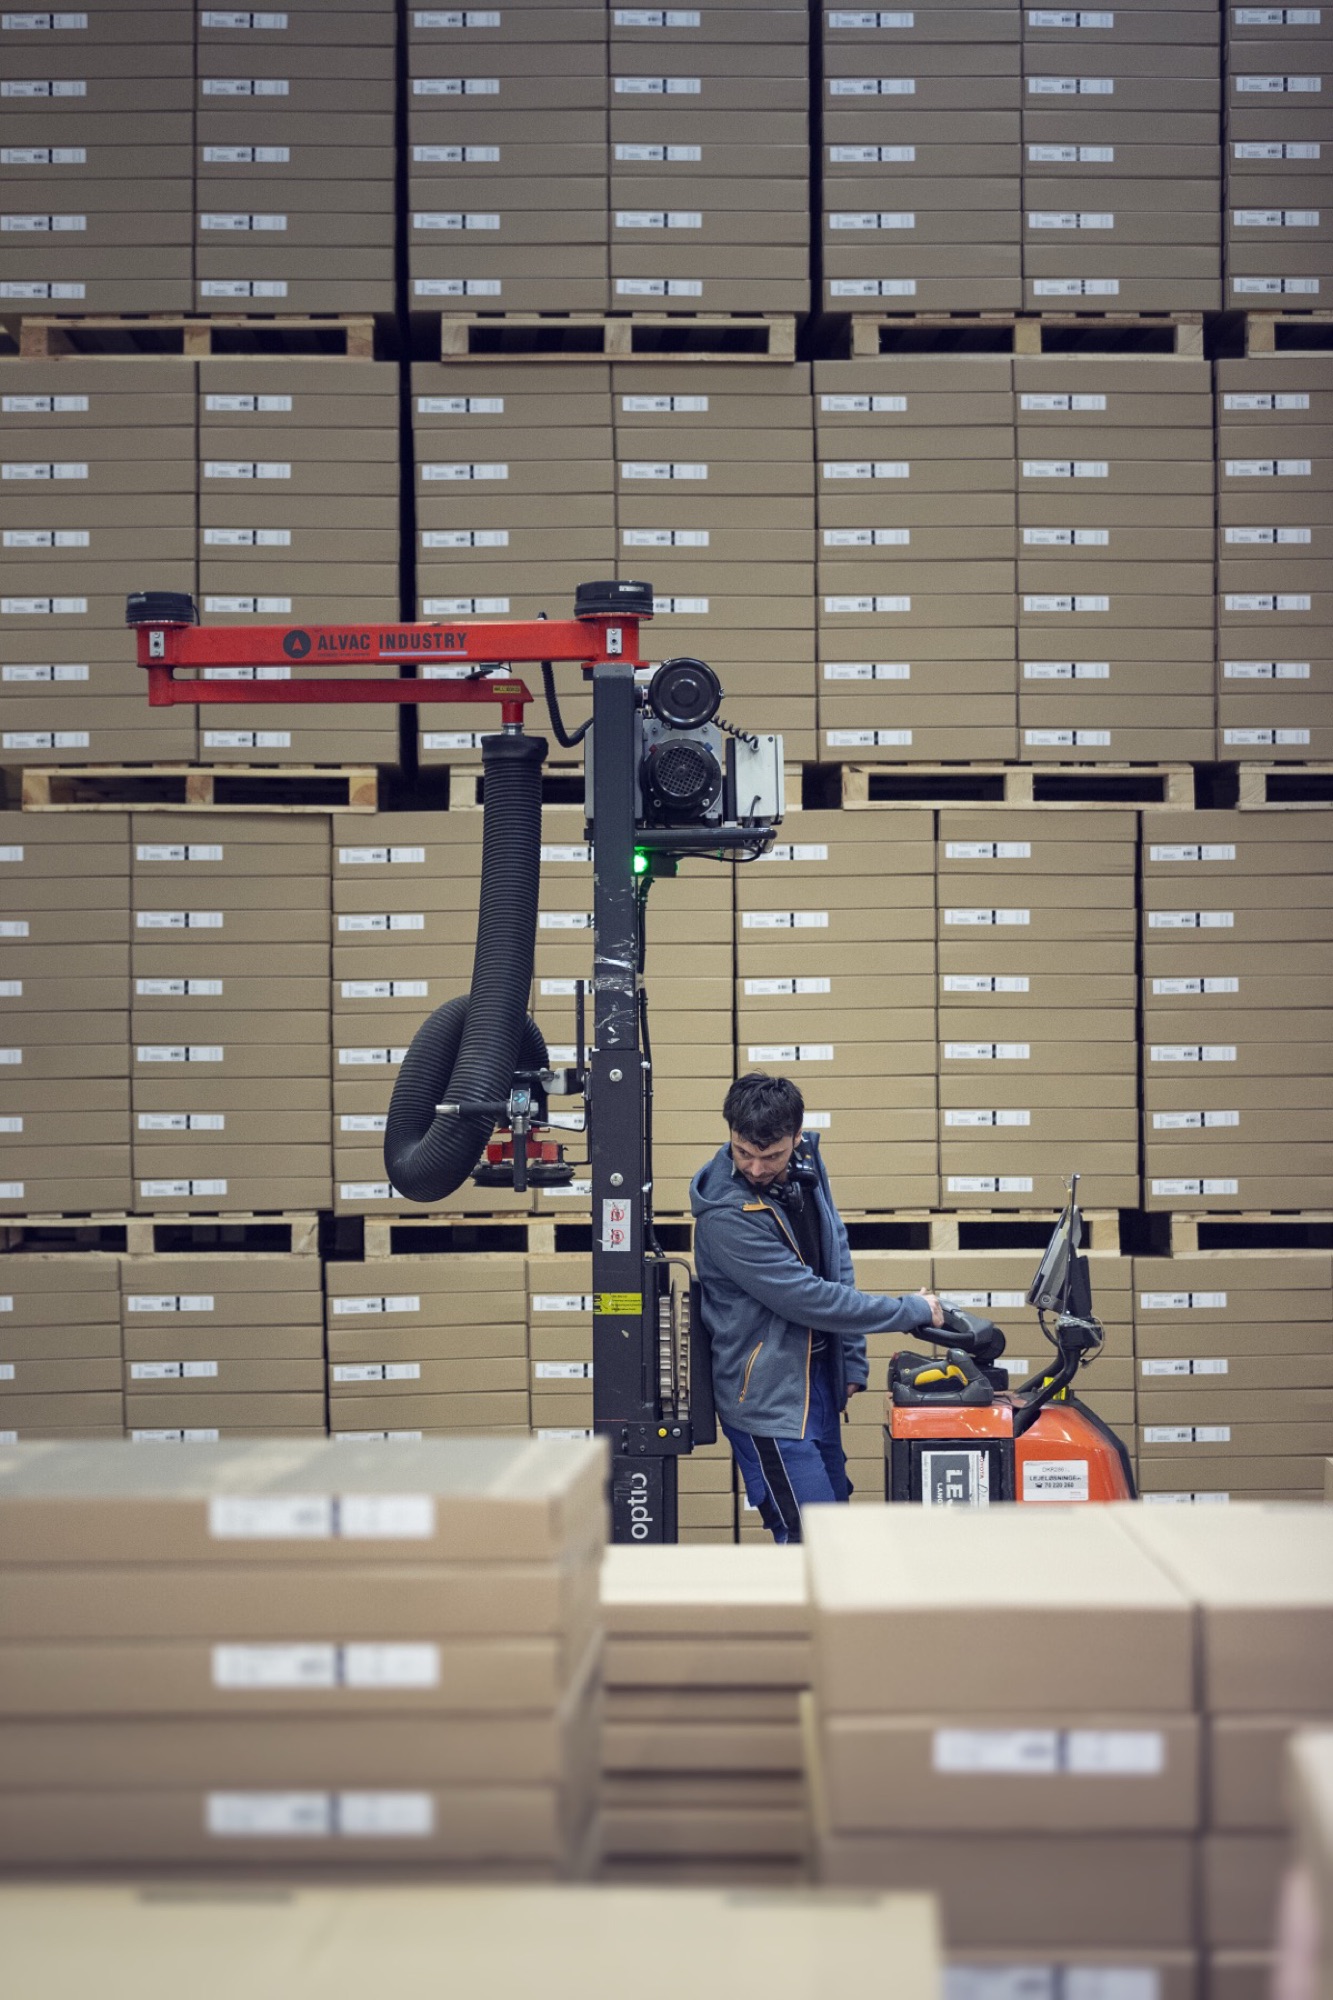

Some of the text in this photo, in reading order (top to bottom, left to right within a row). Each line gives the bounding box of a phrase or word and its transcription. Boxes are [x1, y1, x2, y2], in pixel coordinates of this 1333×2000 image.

[317, 632, 468, 651] ALVAC INDUSTRY
[945, 1469, 963, 1504] LE
